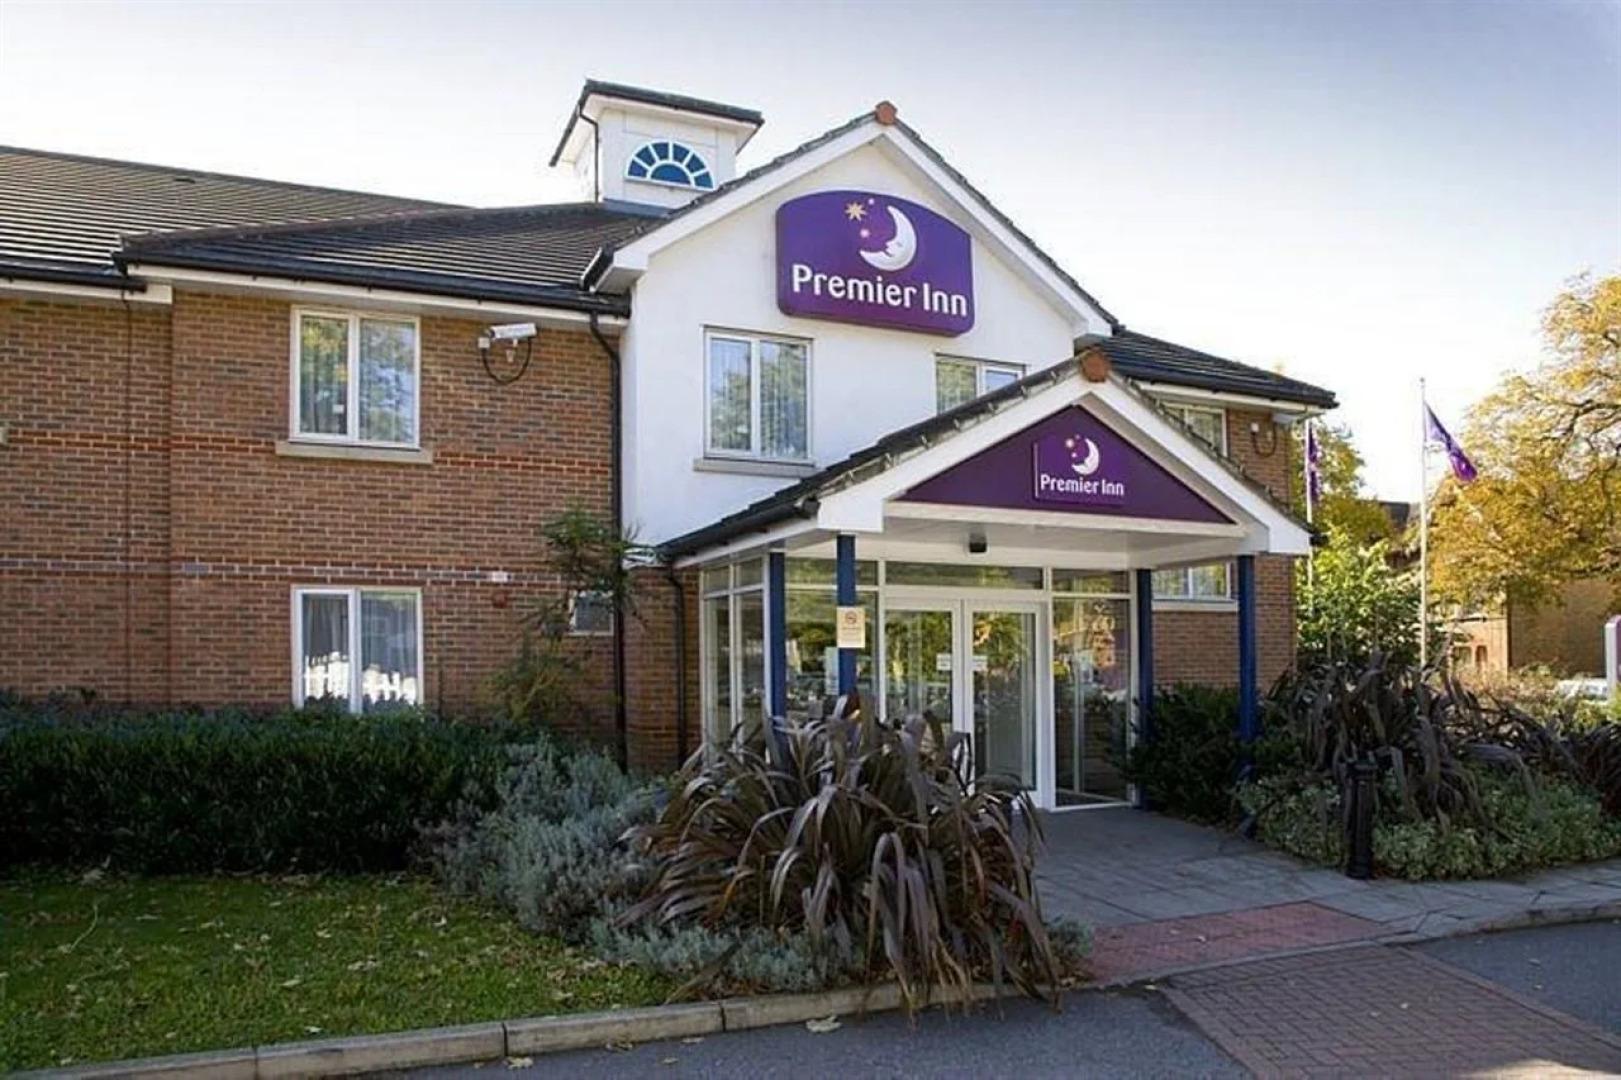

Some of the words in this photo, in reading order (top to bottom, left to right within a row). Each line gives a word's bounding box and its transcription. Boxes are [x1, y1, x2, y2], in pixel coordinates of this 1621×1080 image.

[792, 264, 917, 308] Premier
[923, 283, 967, 317] Inn
[1040, 474, 1099, 494] Premier
[1102, 479, 1125, 496] Inn
